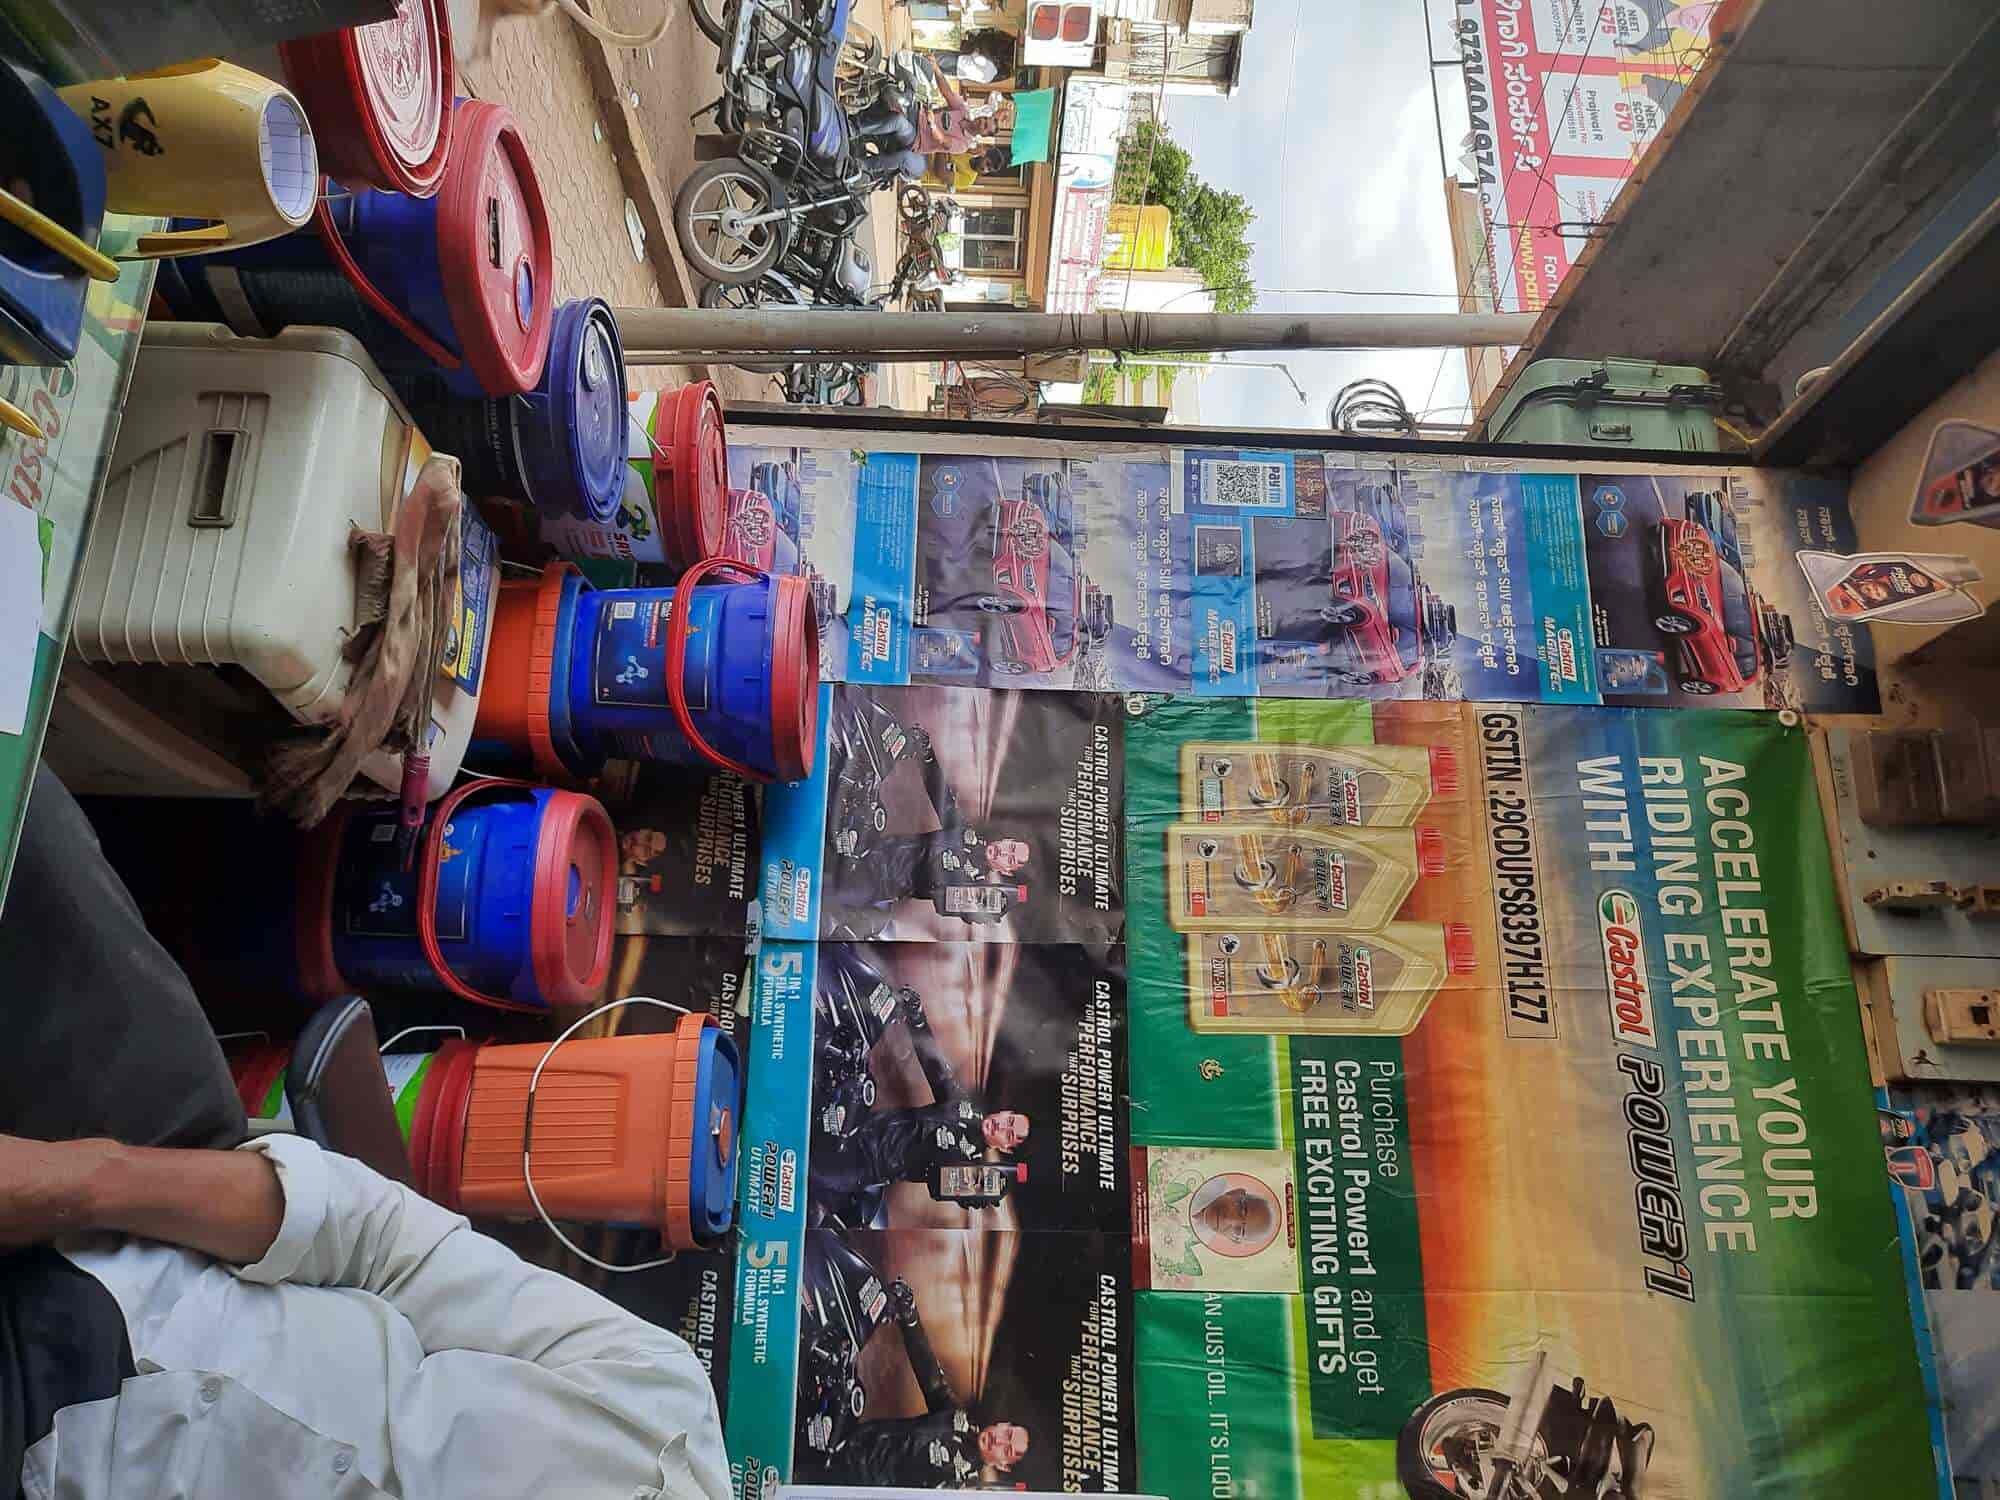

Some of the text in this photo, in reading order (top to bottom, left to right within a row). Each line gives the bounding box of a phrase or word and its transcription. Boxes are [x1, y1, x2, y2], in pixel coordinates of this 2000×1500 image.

[1615, 5, 1640, 38] NEET SCORE
[90, 95, 114, 150] AX7
[1586, 89, 1602, 132] Prajwal
[1614, 102, 1633, 132] 670
[1633, 101, 1657, 137] NEET SCORE
[1543, 256, 1558, 280] For
[1159, 568, 1171, 590] SUV
[1498, 577, 1510, 600] SUV
[860, 595, 874, 672] MAGNATEC
[876, 620, 889, 657] Castrol
[1222, 632, 1235, 670] Castrol
[1536, 645, 1546, 662] SUV
[1544, 616, 1562, 692] MAGNATEC
[1560, 640, 1573, 677] Castrol
[1480, 713, 1524, 783] GSTIN
[714, 769, 736, 867] RFORMANCE
[1077, 761, 1093, 877] PERFORMANCE
[1094, 725, 1109, 911] CASTROL POWER1 ULTIMATE
[1344, 781, 1359, 823] Castrol
[695, 796, 716, 885] SURPRISES
[729, 833, 747, 900] ULTIMATE
[1059, 787, 1076, 896] THAT SURPRISES
[796, 880, 808, 918] Castrol
[1331, 864, 1345, 905] Castrol
[1575, 755, 1636, 872] WITH
[1606, 926, 1651, 1037] Castrol
[762, 951, 802, 976] 5
[788, 977, 801, 1000] IN-1
[1357, 962, 1371, 1006] Castrol
[1698, 754, 1818, 1220] ACCELERATE YOUR
[720, 973, 736, 1035] CASTRO
[761, 976, 773, 1026] FORMULA
[771, 976, 786, 1060] FULL SYNTHETIC
[1637, 755, 1757, 1254] RIDING EXPERIENCE
[1078, 1004, 1096, 1154] FOR PERFORMANCE
[1095, 980, 1114, 1191] CASTROL POWER1 ULTIMATE
[1061, 1052, 1079, 1175] THAT SURPRISES
[1368, 1061, 1401, 1177] Purchase
[748, 1147, 762, 1215] ULTIMATE
[781, 1165, 794, 1208] Castrol
[1300, 1058, 1346, 1375] FREE EXCITING GIFTS
[1334, 1059, 1386, 1395] Castrol Power1 and get
[746, 1240, 788, 1268] 5
[773, 1268, 786, 1295] IN-1
[698, 1270, 717, 1344] CASTROL
[742, 1268, 757, 1326] FORMULA
[754, 1268, 770, 1364] FULL SYNTHETIC
[1081, 1301, 1100, 1472] FOR PERFORMANCE
[1100, 1274, 1119, 1492] CASTROL POWER1 ULTIMA
[1203, 1292, 1232, 1500] AN JUST OIL. IT'S LIQU
[1062, 1355, 1082, 1493] THAT SURPRISES
